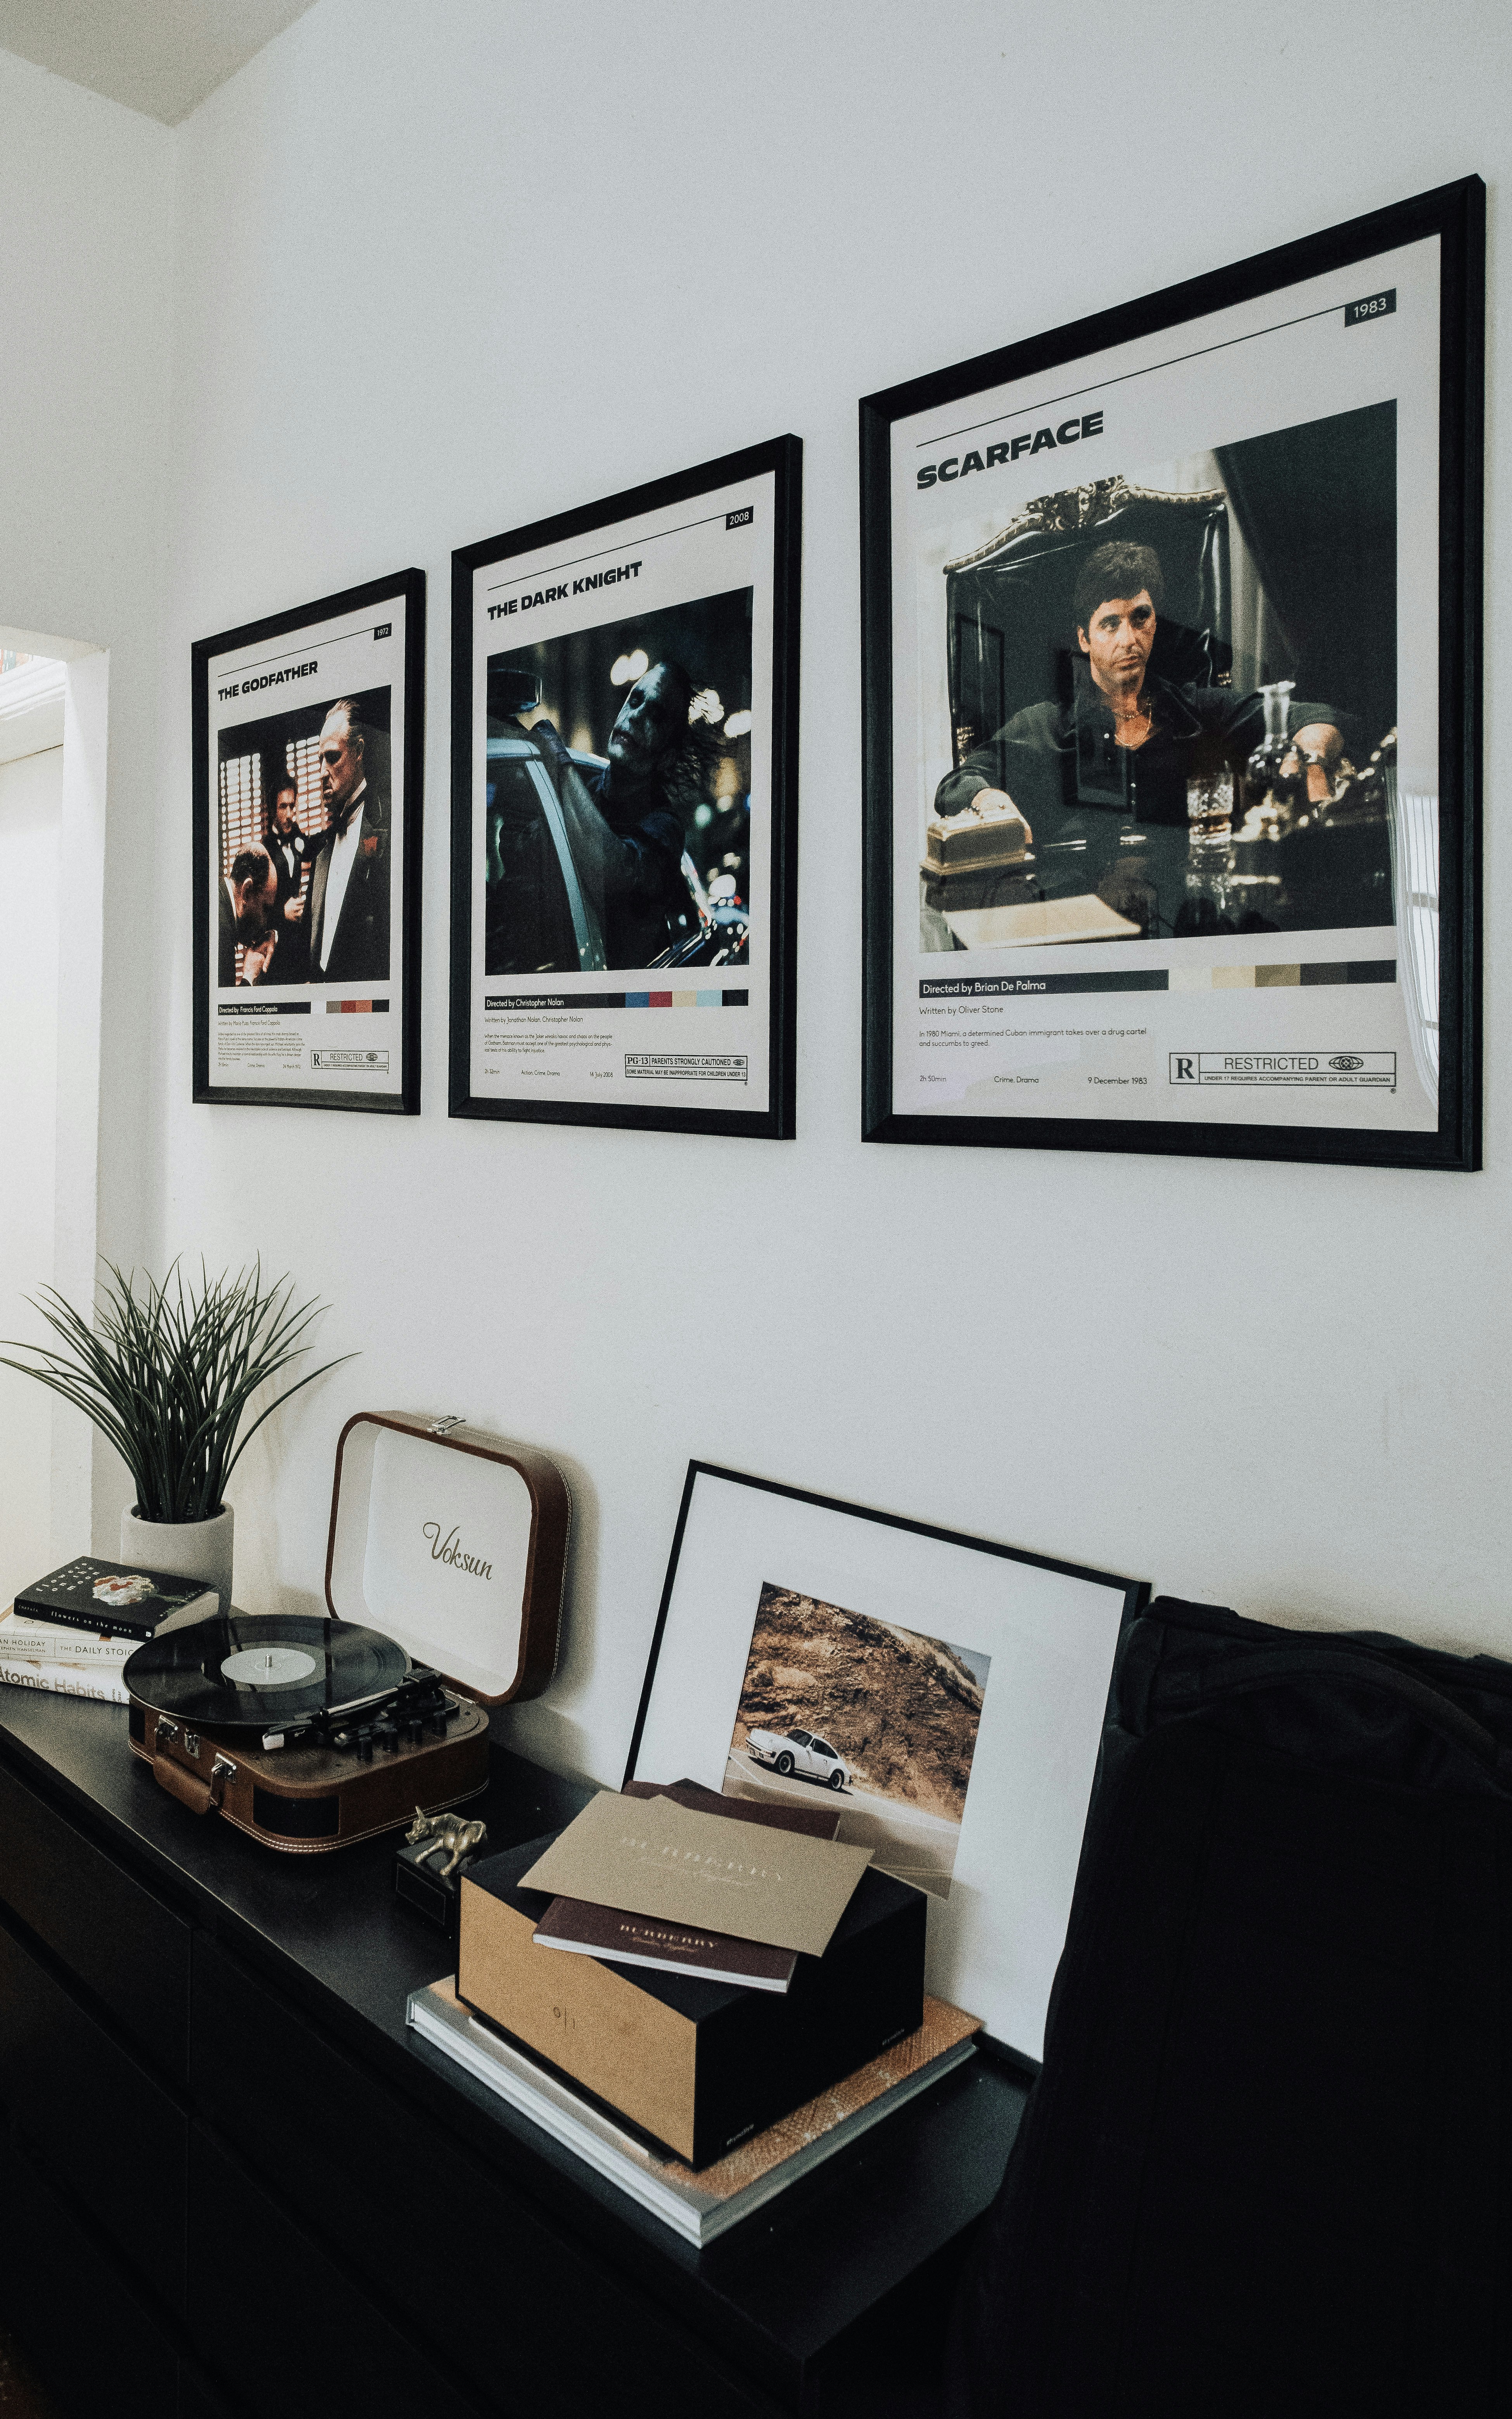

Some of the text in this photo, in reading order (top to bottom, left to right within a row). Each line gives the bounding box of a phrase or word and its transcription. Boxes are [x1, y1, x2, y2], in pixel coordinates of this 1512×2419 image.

[1353, 297, 1387, 317] 1983
[916, 410, 1103, 490] SCARFACE
[729, 512, 749, 525] 2008
[487, 561, 642, 621] THE DARK KNIGHT
[377, 628, 388, 636] 1972
[218, 661, 318, 701] THE GODFATHER
[923, 980, 1046, 995] Directed by Brian De Palma
[508, 999, 515, 1008] by
[516, 999, 546, 1008] Christopher
[948, 1007, 957, 1016] by
[959, 1006, 980, 1014] Oliver
[506, 1016, 526, 1024] Jonathan
[1108, 1028, 1125, 1037] drug
[971, 1040, 989, 1048] greed.
[313, 1053, 320, 1065] R
[1225, 1058, 1318, 1070] RESTRICTED
[1175, 1058, 1195, 1079] R
[422, 1522, 492, 1580] Voksun
[51, 1611, 79, 1622] flowers
[75, 1646, 102, 1654] DAILY
[54, 1677, 105, 1700] Habits
